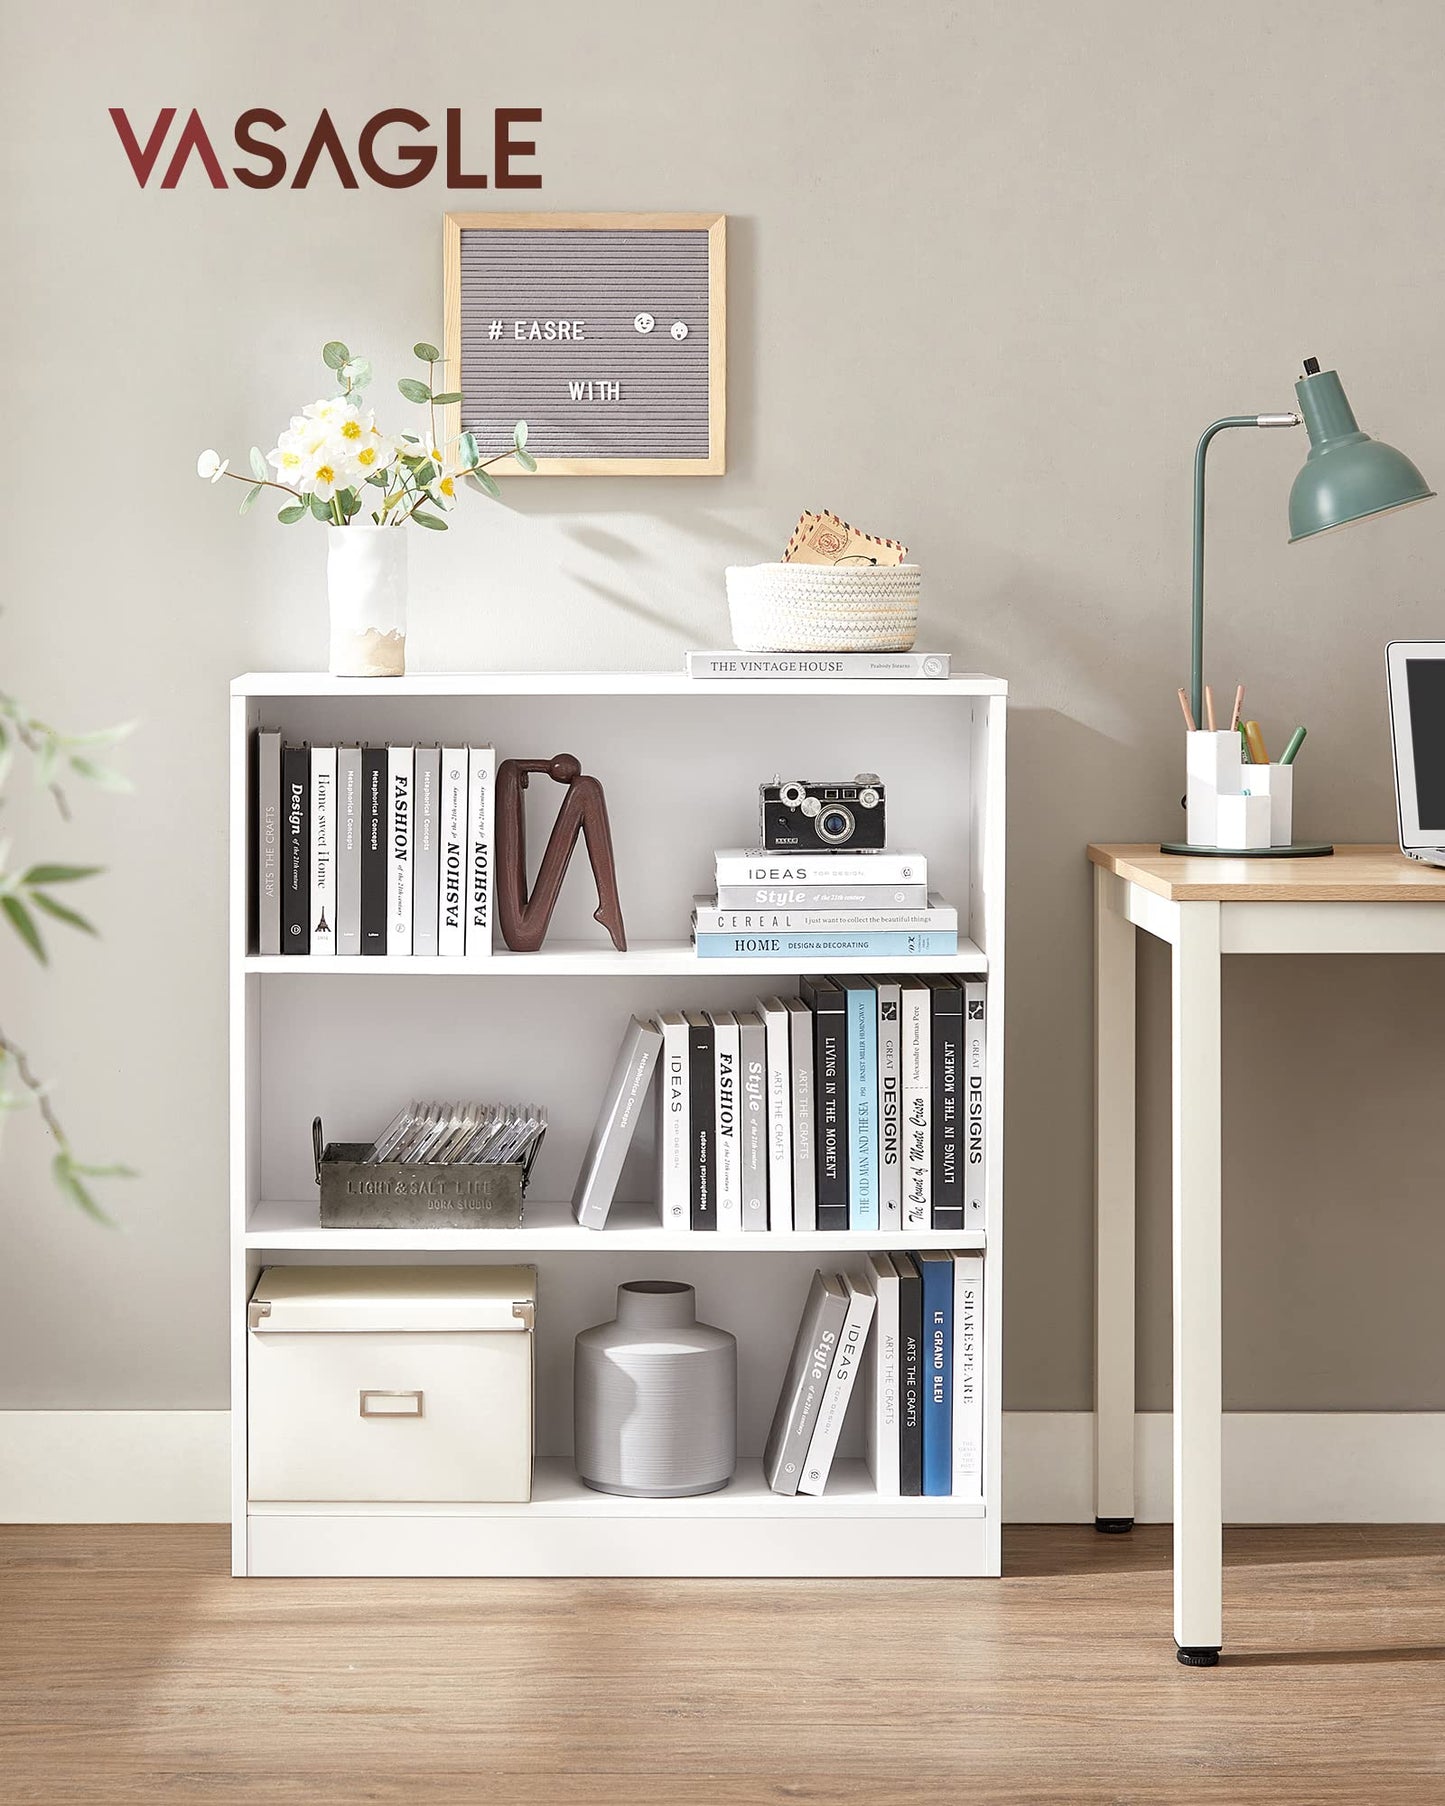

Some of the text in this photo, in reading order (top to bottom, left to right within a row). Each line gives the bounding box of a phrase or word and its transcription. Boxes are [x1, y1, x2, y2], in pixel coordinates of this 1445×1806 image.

[514, 321, 585, 341] EASRE
[568, 381, 620, 401] WITH
[710, 661, 844, 672] THE VINTAGE HOUSE
[289, 783, 304, 835] Design
[317, 774, 330, 889] Home sweet Home
[346, 770, 354, 850] Metaphorical Concepts
[371, 770, 379, 850] Metaphorical Concepts
[395, 775, 408, 861] FASHION
[423, 771, 431, 851] Metaphorical Concepts
[265, 806, 275, 897] ARTS THE CRAFTS
[749, 868, 807, 880] IDEAS
[446, 842, 460, 928] FASHION
[474, 842, 487, 928] FASHION
[755, 889, 806, 906] Style
[718, 916, 791, 928] CEREAL
[808, 917, 821, 925] just
[911, 916, 931, 924] things
[735, 939, 780, 951] HOME
[671, 1055, 682, 1113] IDEAS
[720, 1053, 734, 1138] FASHION
[745, 1061, 763, 1112] Style
[825, 1037, 837, 1179] LIVING IN THE MOMENT
[858, 1101, 869, 1116] SEA
[884, 1040, 898, 1166] GREAT DESIGNS
[970, 1039, 982, 1165] GREAT DESIGNS
[620, 1097, 635, 1129] Concepts
[774, 1070, 784, 1161] ARTS THE CRAFTS
[798, 1068, 809, 1159] ARTS THE CRAFTS
[859, 1116, 869, 1135] THE
[944, 1041, 955, 1184] LIVING IN THE MOMENT
[859, 1135, 869, 1156] AND
[859, 1157, 869, 1176] MAN
[909, 1130, 925, 1162] Monte
[347, 1181, 392, 1195] LIGHT
[700, 1165, 708, 1210] Metaphorical
[859, 1177, 870, 1196] OLD
[859, 1198, 870, 1215] THE
[908, 1177, 927, 1204] Count
[908, 1206, 924, 1223] The
[811, 1330, 835, 1380] Style
[836, 1324, 861, 1381] IDEAS
[934, 1311, 944, 1403] LE GRAND BLEU
[964, 1290, 974, 1404] SHAKESPEARE
[885, 1335, 894, 1425] ARTS THE CRAFTS
[907, 1336, 916, 1427] ARTS THE CRAFTS
